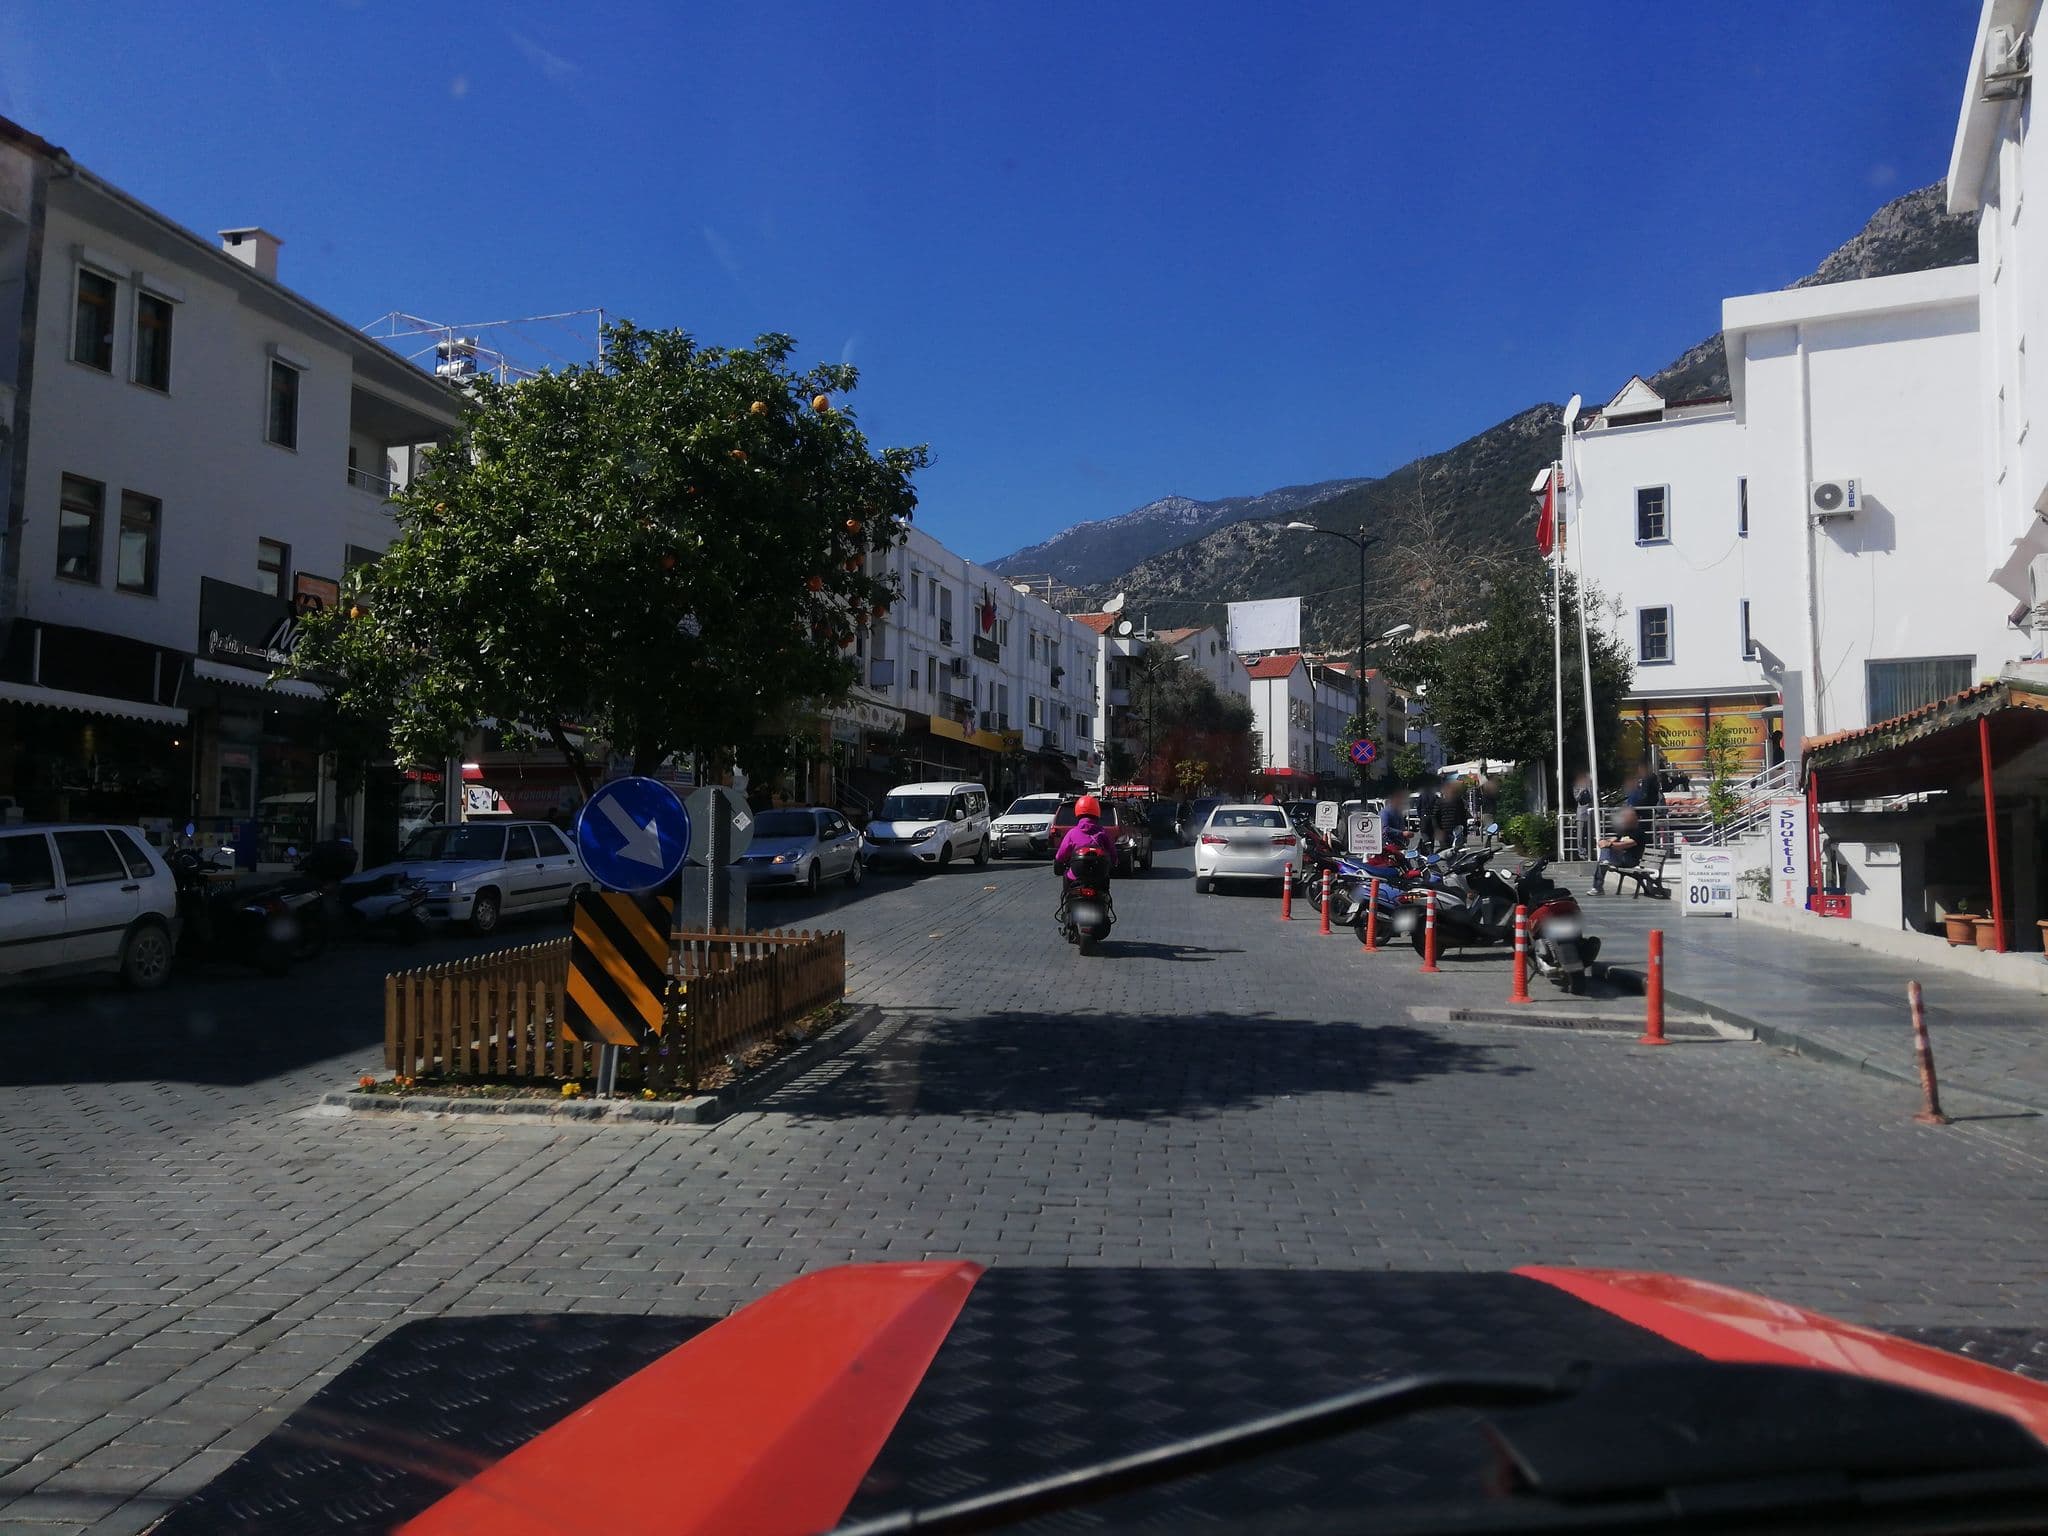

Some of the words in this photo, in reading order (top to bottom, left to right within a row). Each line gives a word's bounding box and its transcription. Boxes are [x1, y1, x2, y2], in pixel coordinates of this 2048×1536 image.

[1664, 739, 1686, 747] SHOP
[1779, 809, 1796, 874] Shuttle
[1690, 885, 1709, 904] 80
